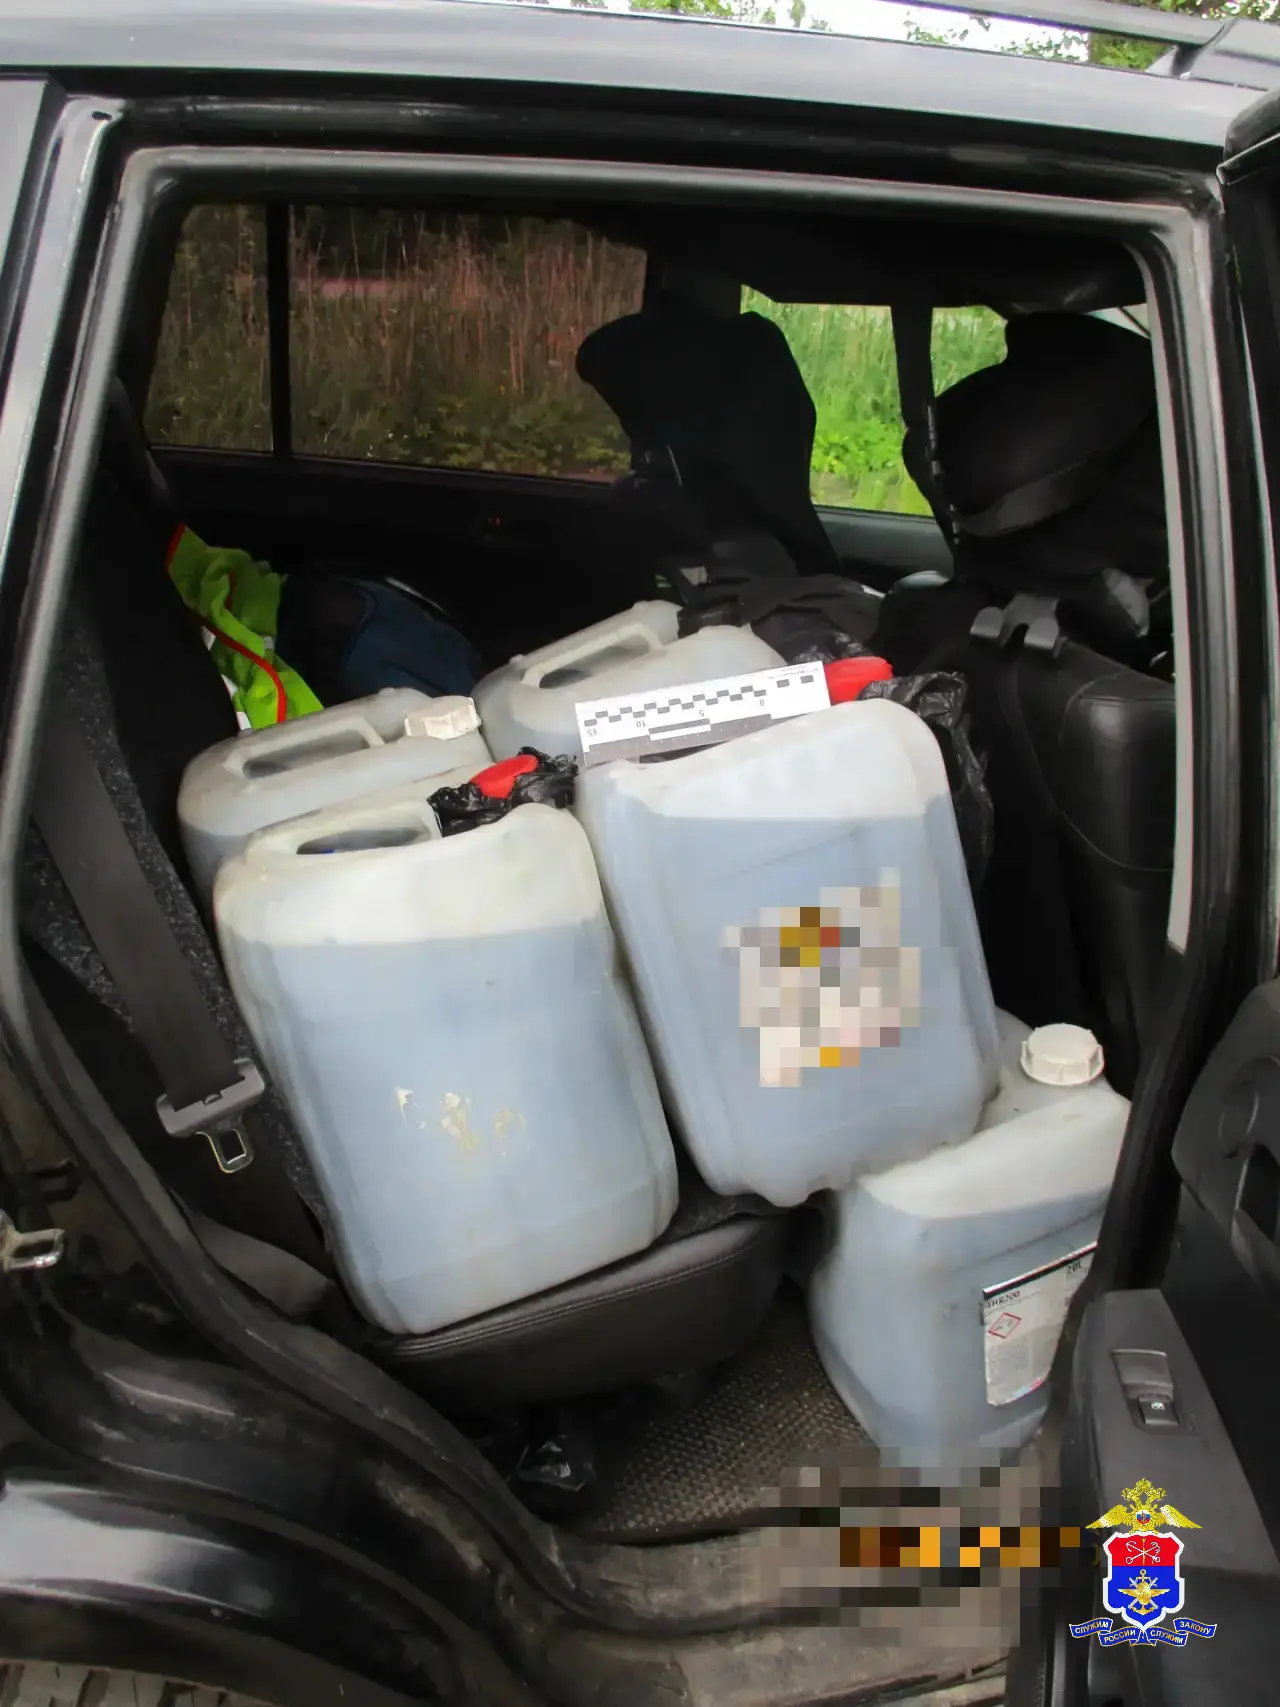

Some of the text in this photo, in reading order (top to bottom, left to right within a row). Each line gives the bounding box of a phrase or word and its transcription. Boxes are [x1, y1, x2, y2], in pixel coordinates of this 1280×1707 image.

[699, 709, 705, 717] 5
[636, 720, 646, 729] 10
[587, 728, 598, 737] 15
